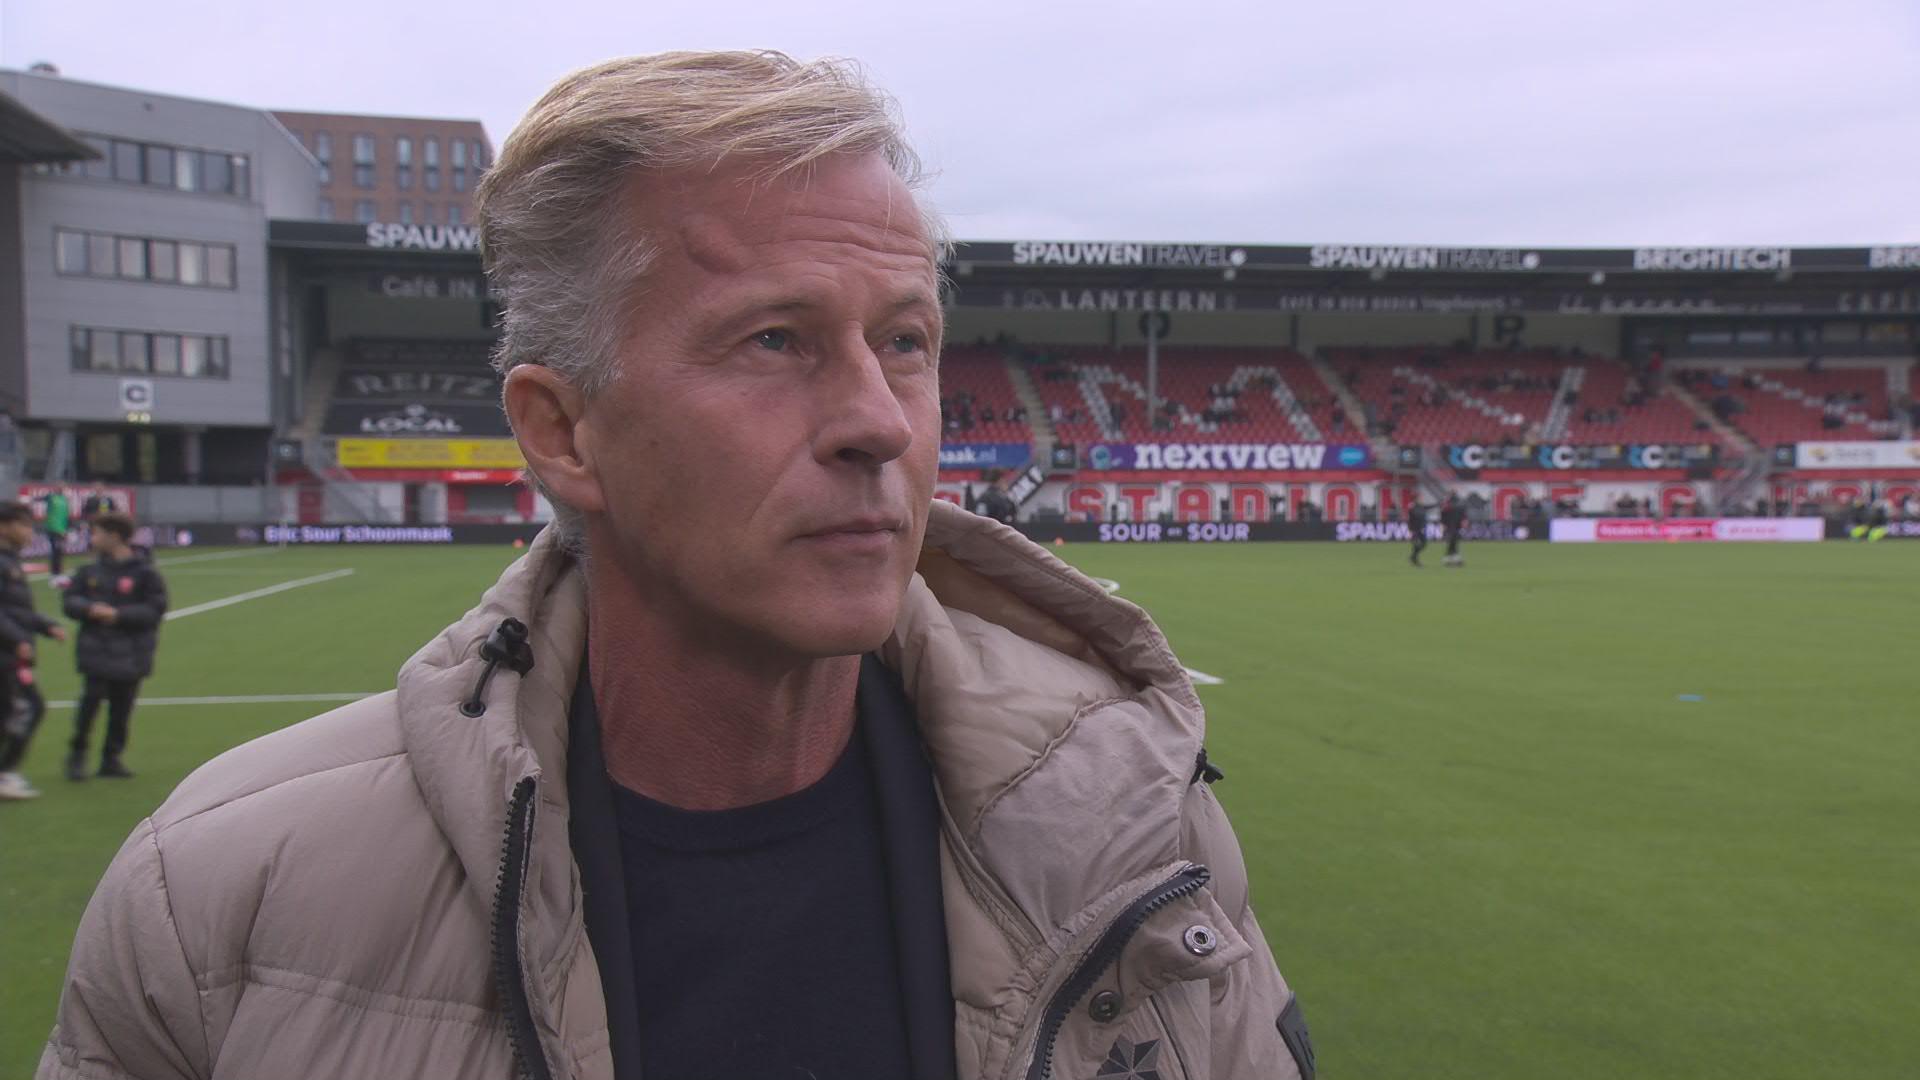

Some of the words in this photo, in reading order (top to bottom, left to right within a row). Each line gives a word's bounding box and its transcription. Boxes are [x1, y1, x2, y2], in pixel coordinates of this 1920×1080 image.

[367, 222, 482, 250] SPAUW
[1633, 248, 1790, 270] BRIGHTECH
[360, 417, 462, 433] LOCAL
[1134, 444, 1326, 471] nextview
[303, 527, 341, 543] Sour
[344, 526, 453, 542] Schoonmaak
[1098, 523, 1163, 542] SOUR
[1187, 523, 1250, 541] SOUR
